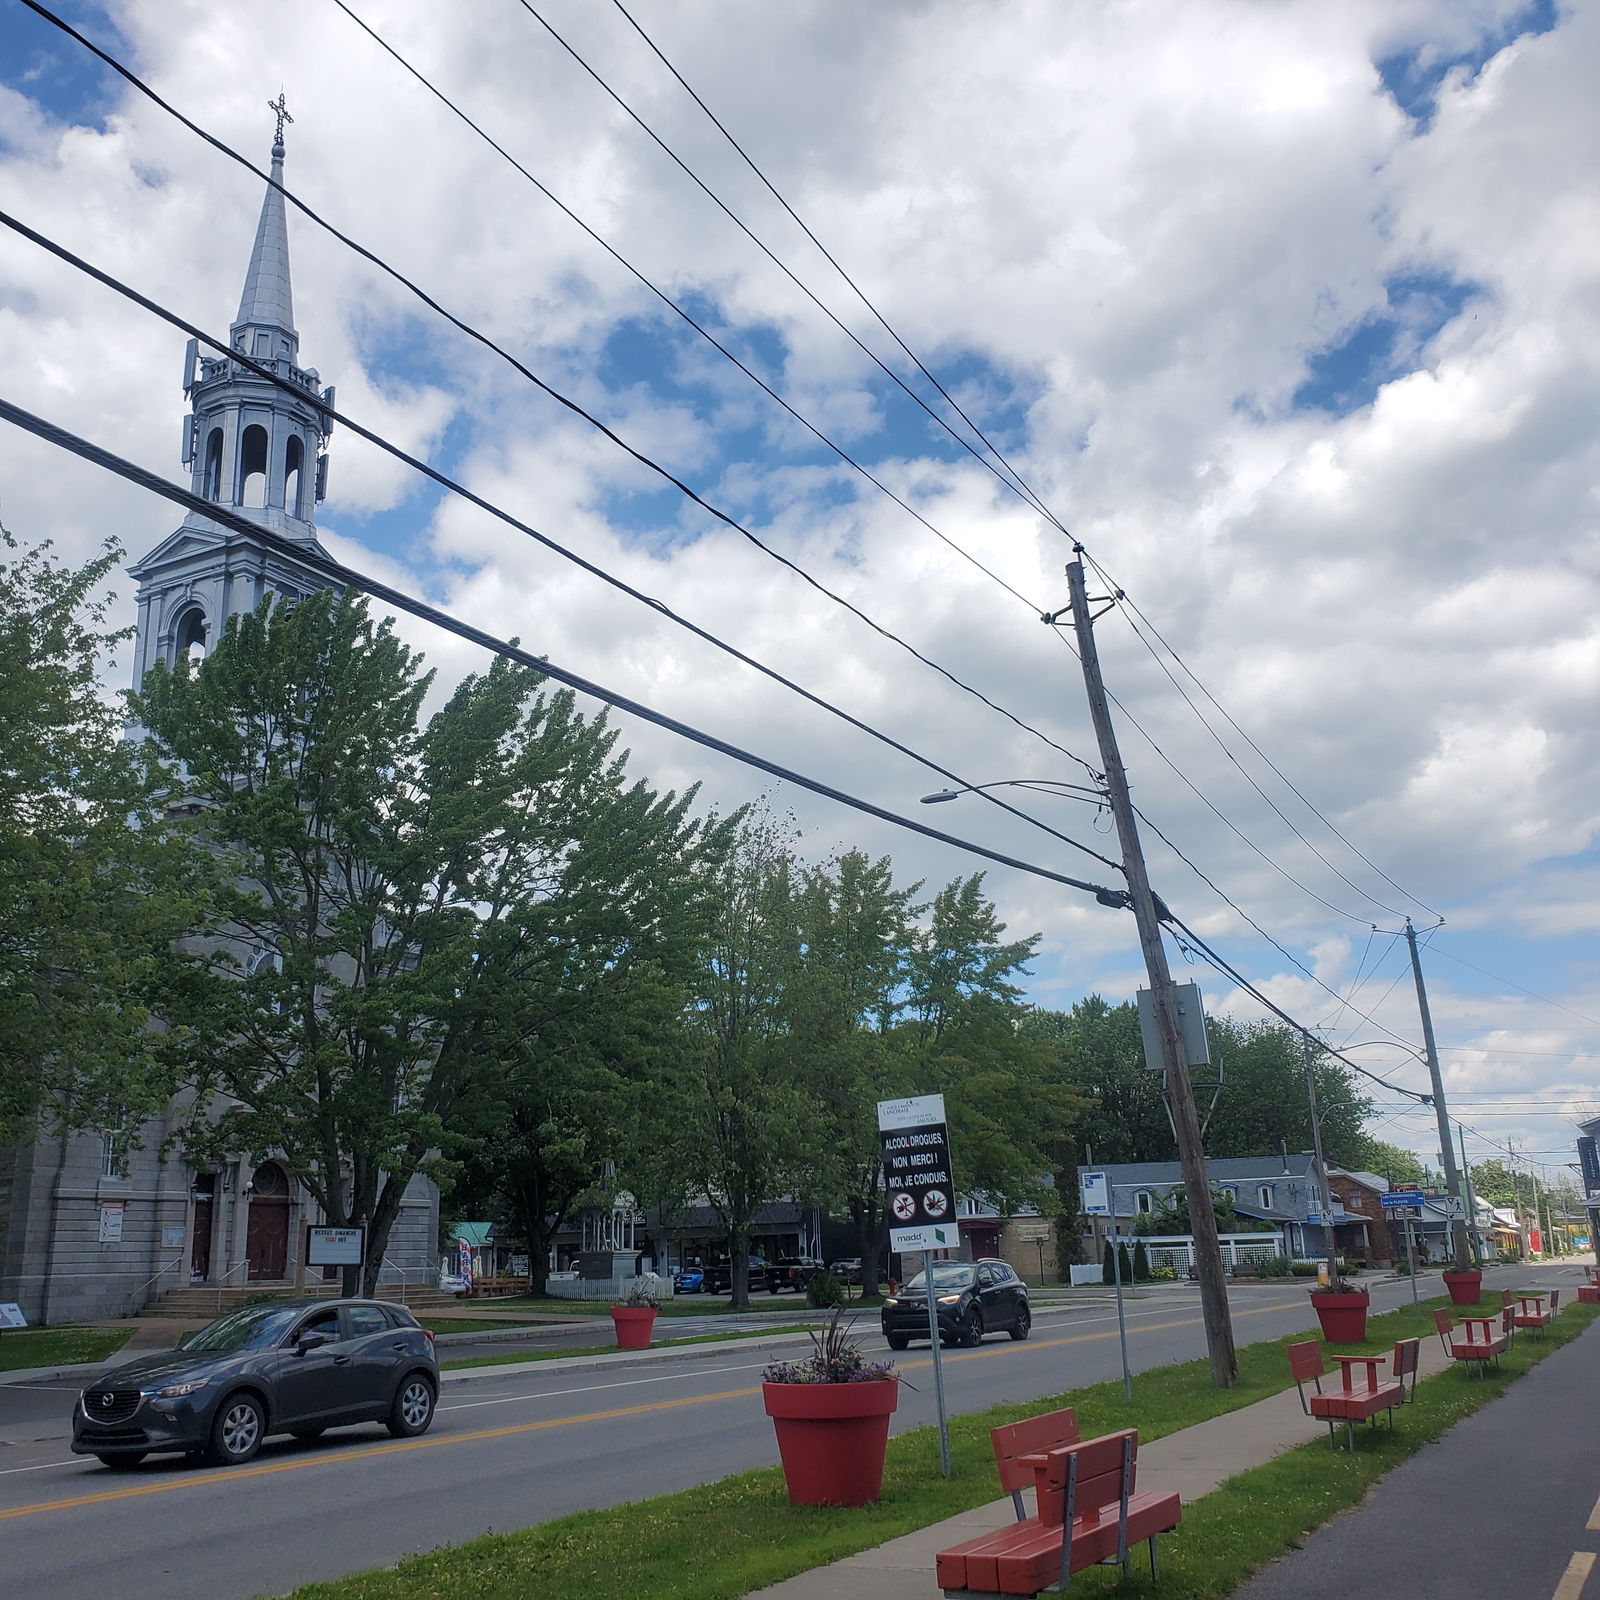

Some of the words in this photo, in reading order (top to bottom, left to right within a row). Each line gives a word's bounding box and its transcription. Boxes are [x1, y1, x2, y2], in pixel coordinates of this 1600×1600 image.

[886, 1136, 910, 1150] ALCOOL
[910, 1132, 944, 1147] DROGUES,
[892, 1156, 908, 1168] NON
[910, 1153, 934, 1166] MERCI
[889, 1176, 904, 1189] MOI,
[904, 1175, 913, 1187] JE
[914, 1171, 949, 1185] CONDUIS.
